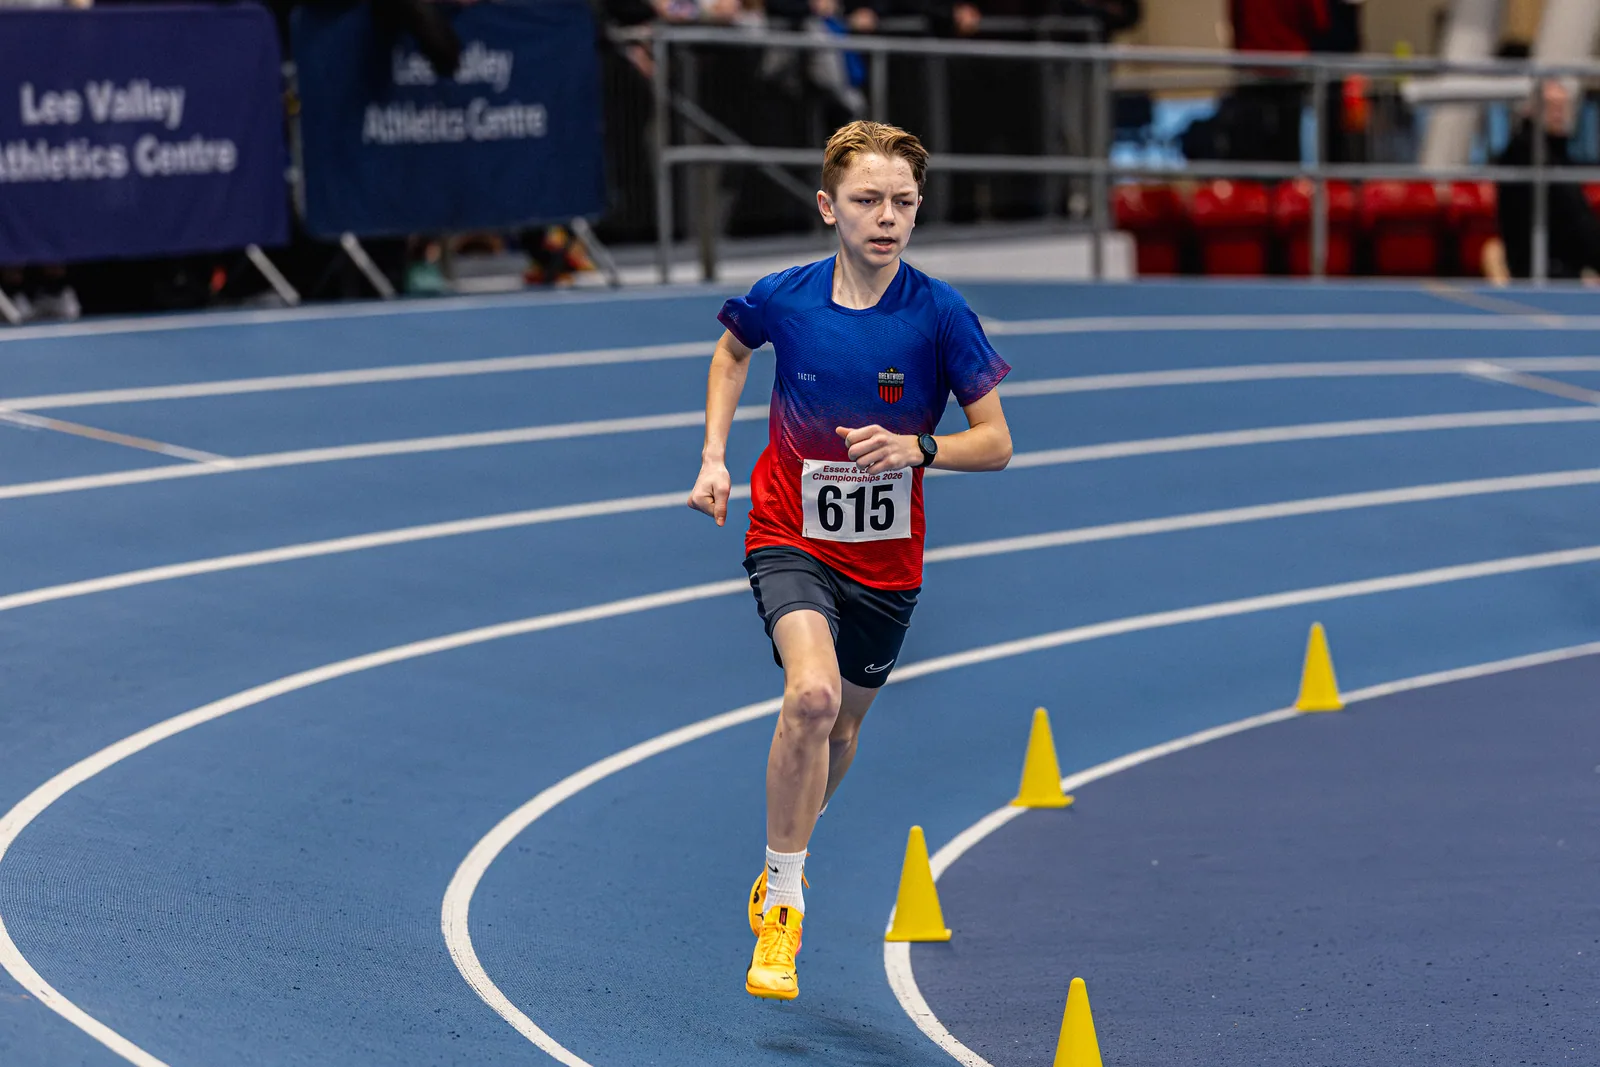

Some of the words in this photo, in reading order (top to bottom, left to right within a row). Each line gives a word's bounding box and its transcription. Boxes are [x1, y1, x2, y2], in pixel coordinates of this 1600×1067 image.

[20, 82, 83, 125] Lee
[85, 79, 185, 131] Valley
[362, 103, 466, 145] Athletics
[466, 98, 548, 142] Centre
[0, 139, 129, 182] thletics
[134, 135, 238, 177] Centre
[812, 473, 880, 483] Championships
[882, 472, 903, 481] 2026
[823, 465, 850, 474] Essex
[851, 466, 858, 474] &
[817, 484, 895, 533] 615
